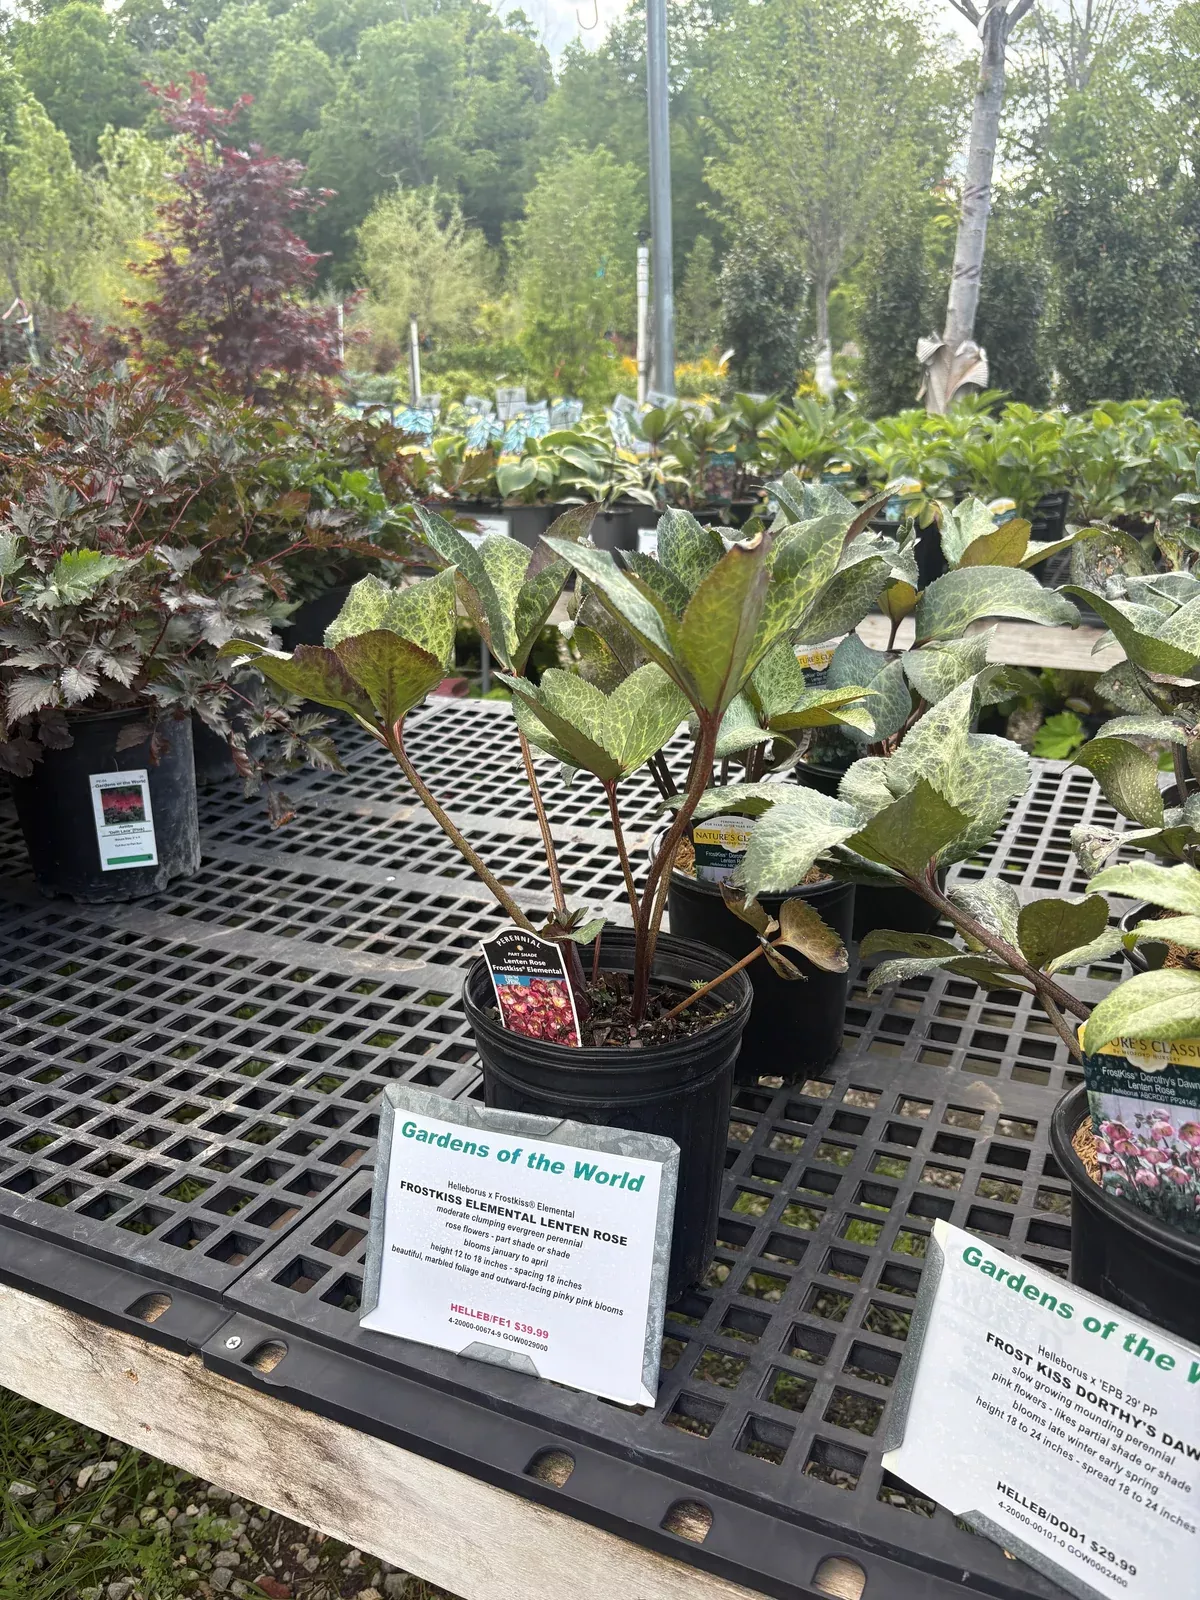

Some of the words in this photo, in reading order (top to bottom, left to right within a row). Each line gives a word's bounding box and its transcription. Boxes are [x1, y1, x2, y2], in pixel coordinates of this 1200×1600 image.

[695, 831, 735, 842] NATURE'S
[496, 934, 541, 949] PERENNIAL
[503, 957, 528, 965] Lenten
[528, 959, 546, 967] Rose
[526, 966, 563, 975] Elemental
[1110, 1035, 1147, 1051] URE'S
[1127, 1079, 1155, 1092] Lenten
[1155, 1084, 1176, 1096] Rose
[1139, 1072, 1176, 1087] Dorothy's
[401, 1120, 490, 1158] Gardens
[496, 1147, 523, 1164] of
[526, 1151, 565, 1174] the
[573, 1160, 645, 1192] World
[399, 1179, 462, 1205] FROSTKISS
[465, 1197, 536, 1224] ELEMENTAL
[539, 1216, 589, 1237] LENTEN
[592, 1229, 627, 1246] ROSE
[447, 1179, 486, 1197] Helleborus
[487, 1191, 493, 1199] x
[536, 1201, 575, 1218] Elemental
[435, 1205, 470, 1220] moderate
[471, 1214, 505, 1230] clumping
[506, 1224, 545, 1239] evergreen
[545, 1233, 583, 1248] perennial
[444, 1221, 461, 1231] rose
[462, 1224, 489, 1238] flowers
[494, 1234, 511, 1244] part
[511, 1238, 535, 1250] shade
[546, 1246, 570, 1259] shade
[429, 1241, 453, 1255] height
[453, 1248, 463, 1258] 12
[463, 1251, 472, 1260] to
[473, 1254, 482, 1263] 18
[482, 1256, 508, 1270] inches
[513, 1266, 544, 1282] spacing
[546, 1273, 555, 1283] 18
[556, 1275, 582, 1290] inches
[463, 1237, 491, 1252] blooms
[490, 1245, 520, 1261] january
[521, 1253, 529, 1262] to
[530, 1257, 549, 1267] april
[391, 1243, 423, 1261] beautiful,
[424, 1255, 454, 1268] marbled
[454, 1261, 479, 1276] foliage
[479, 1271, 495, 1280] and
[495, 1275, 551, 1297] outward-facing
[552, 1290, 575, 1303] pinky
[574, 1296, 593, 1307] pink
[593, 1300, 623, 1316] blooms
[450, 1302, 510, 1328] HELLEB/FE1
[513, 1321, 549, 1339] $39.99
[961, 1245, 1074, 1319] Gardens
[1082, 1316, 1119, 1340] of
[1123, 1332, 1176, 1371] the
[447, 1316, 501, 1337] 4-20000-00674-9
[502, 1332, 548, 1351] GOW0029000
[985, 1331, 1033, 1366] FROST
[1035, 1360, 1071, 1389] KISS
[1075, 1383, 1156, 1437] DORTHY'S
[1037, 1343, 1088, 1380] Helleborus
[1089, 1376, 1096, 1386] x
[1141, 1402, 1157, 1417] PP
[991, 1372, 1012, 1389] pink
[1013, 1382, 1047, 1409] flowers
[1053, 1407, 1076, 1427] likes
[1076, 1423, 1110, 1447] partial
[1110, 1443, 1142, 1466] shade
[1143, 1462, 1157, 1473] or
[1156, 1470, 1191, 1493] shade
[1011, 1366, 1033, 1383] slow
[1033, 1379, 1072, 1408] growing
[1073, 1401, 1124, 1438] mounding
[1123, 1433, 1176, 1465] perennial
[975, 1395, 1004, 1419] height
[1006, 1414, 1017, 1426] 18
[1018, 1421, 1028, 1433] to
[1029, 1427, 1042, 1441] 24
[1042, 1435, 1074, 1461] inches
[1080, 1461, 1116, 1486] spread
[1118, 1482, 1130, 1495] 18
[1131, 1490, 1142, 1503] to
[1144, 1497, 1158, 1512] 24
[1158, 1506, 1196, 1534] inches
[1011, 1399, 1046, 1426] blooms
[1047, 1420, 1065, 1438] late
[1067, 1434, 1098, 1457] winter
[1098, 1454, 1124, 1474] early
[1124, 1469, 1159, 1495] spring
[996, 1480, 1085, 1544] HELLEB/DOD1
[1089, 1540, 1137, 1576] $29.99
[997, 1500, 1065, 1547] 4-20000-00101-0
